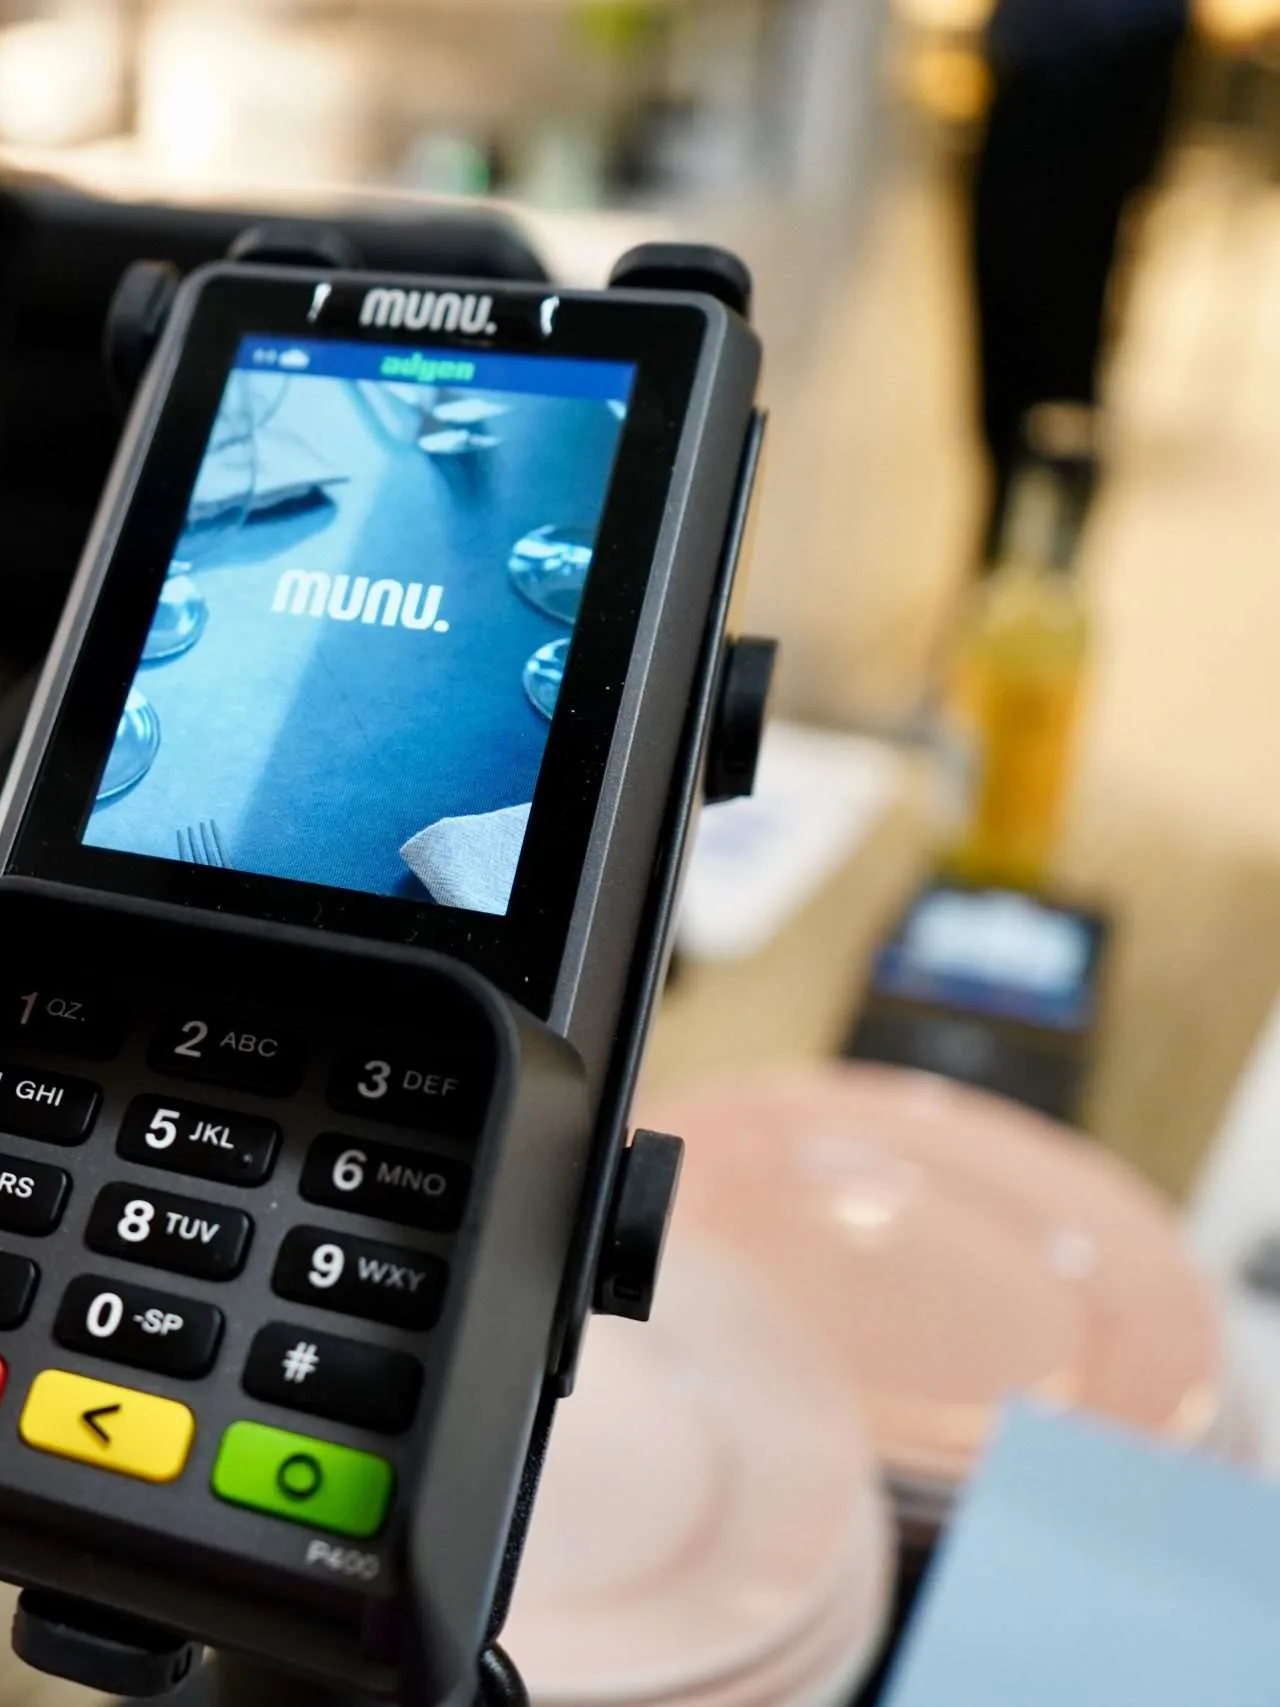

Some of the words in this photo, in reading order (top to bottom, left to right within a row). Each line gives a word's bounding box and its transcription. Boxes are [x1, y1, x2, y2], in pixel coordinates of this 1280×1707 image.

[20, 991, 38, 1025] 1
[174, 1020, 208, 1058] 2
[219, 1031, 278, 1058] ABC
[15, 1080, 64, 1107] GHI
[357, 1060, 391, 1099] 3
[402, 1070, 458, 1097] DEF
[145, 1108, 180, 1149] 5
[188, 1121, 234, 1149] JKL
[332, 1150, 365, 1191] 6
[376, 1161, 446, 1196] MNO
[117, 1199, 155, 1242] 8
[166, 1211, 220, 1244] TUV
[308, 1243, 345, 1288] 9
[358, 1256, 425, 1291] WXY
[86, 1292, 124, 1337] 0
[283, 1341, 319, 1382] #
